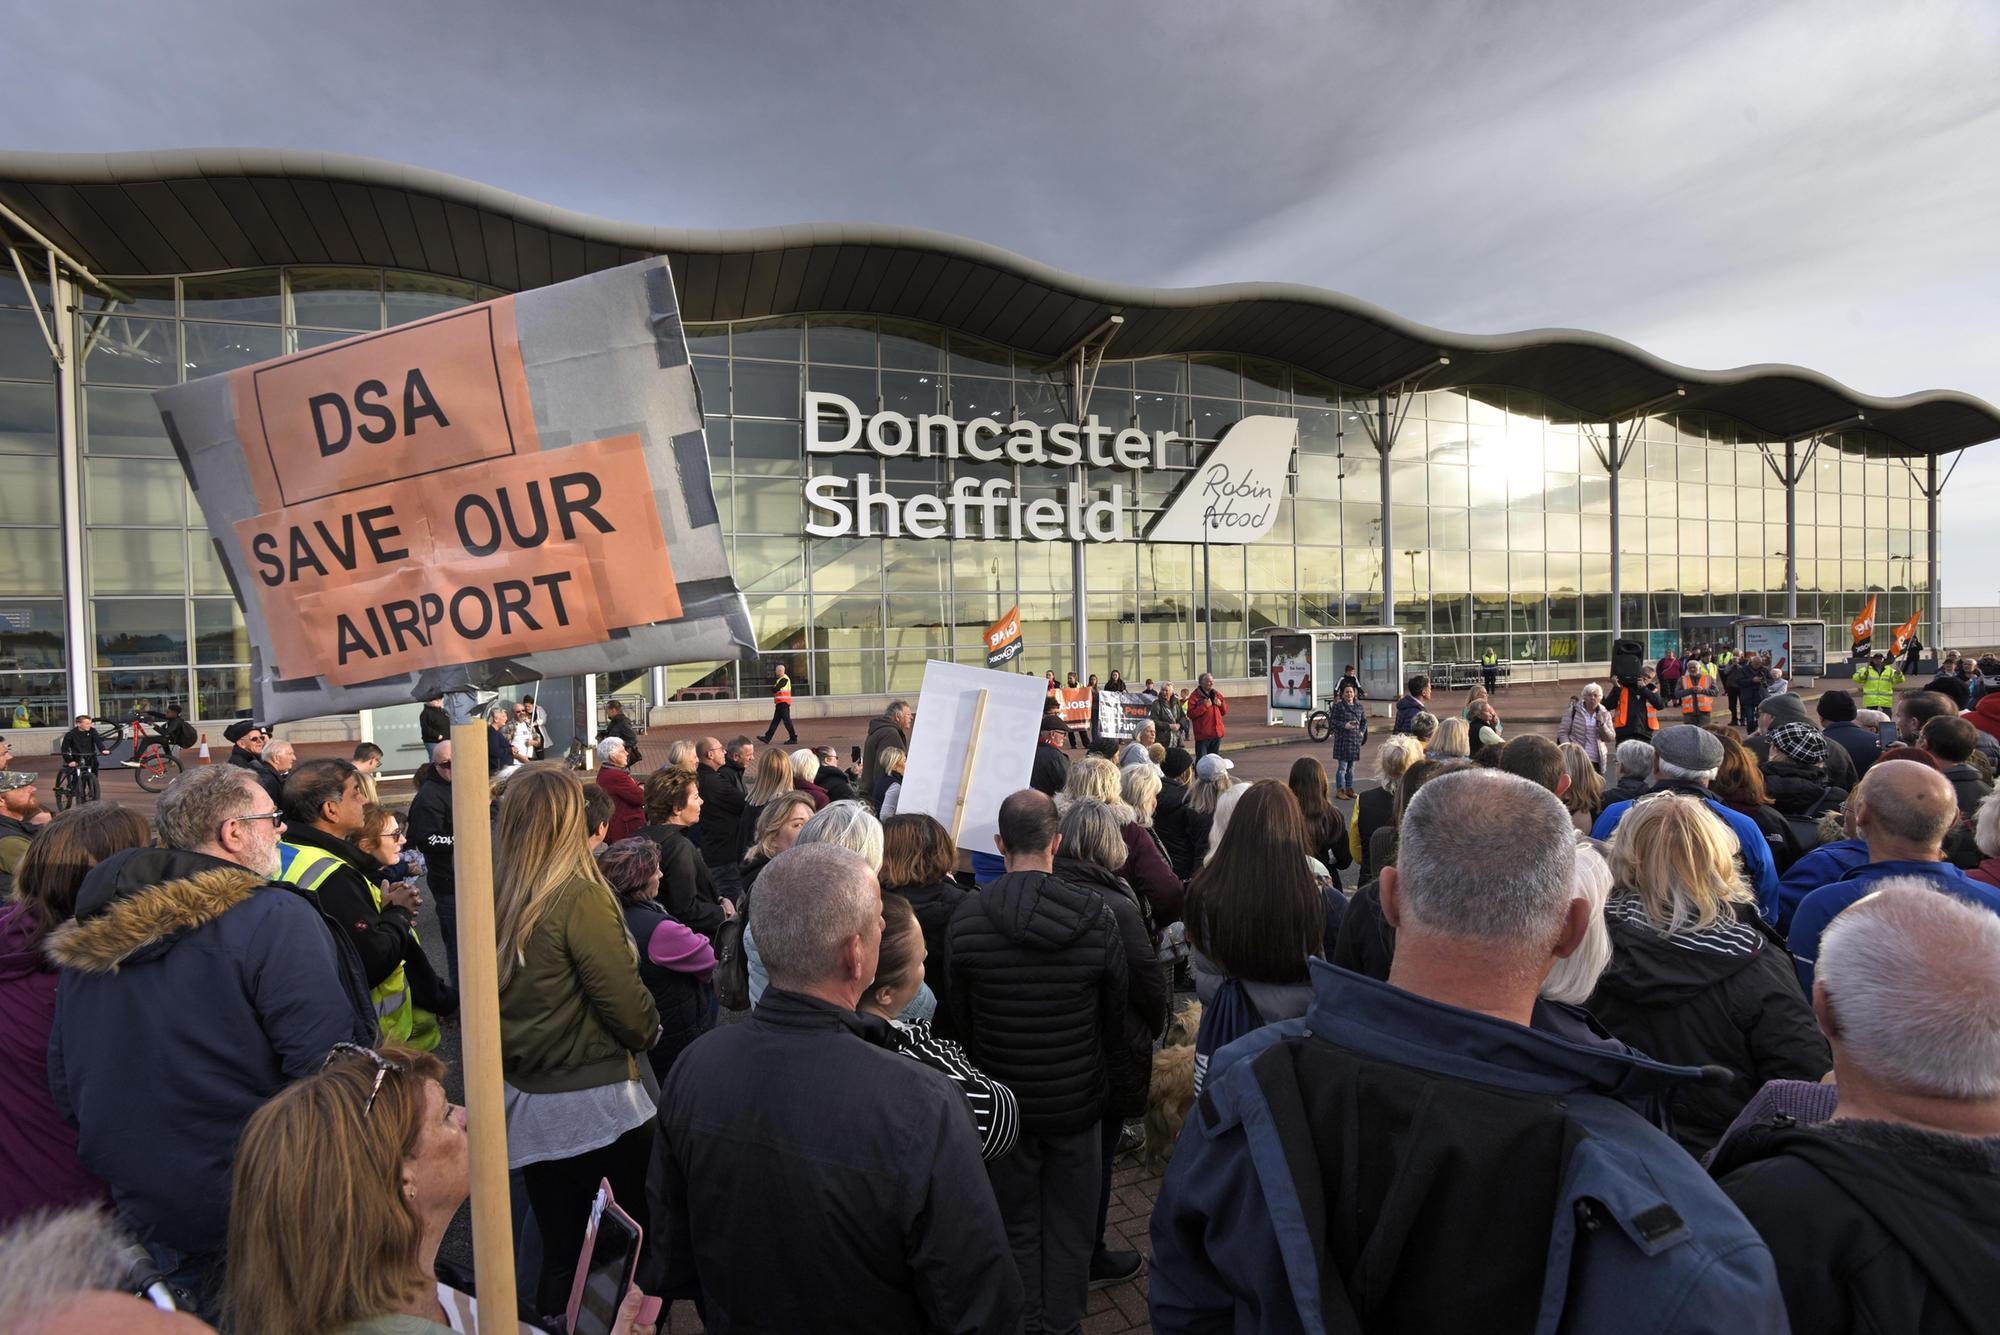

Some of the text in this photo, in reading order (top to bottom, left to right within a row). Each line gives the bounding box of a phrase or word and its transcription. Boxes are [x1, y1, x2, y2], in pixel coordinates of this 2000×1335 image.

[309, 368, 450, 457] DSA
[805, 391, 1178, 470] Doncaster
[805, 473, 1123, 542] Sheffield
[1203, 463, 1271, 498] Robin
[1203, 498, 1271, 528] Hood
[252, 471, 616, 588] SAVE OUR
[337, 571, 573, 666] AIRPORT
[1521, 639, 1577, 657] SUWAY
[1066, 701, 1090, 710] JOBS
